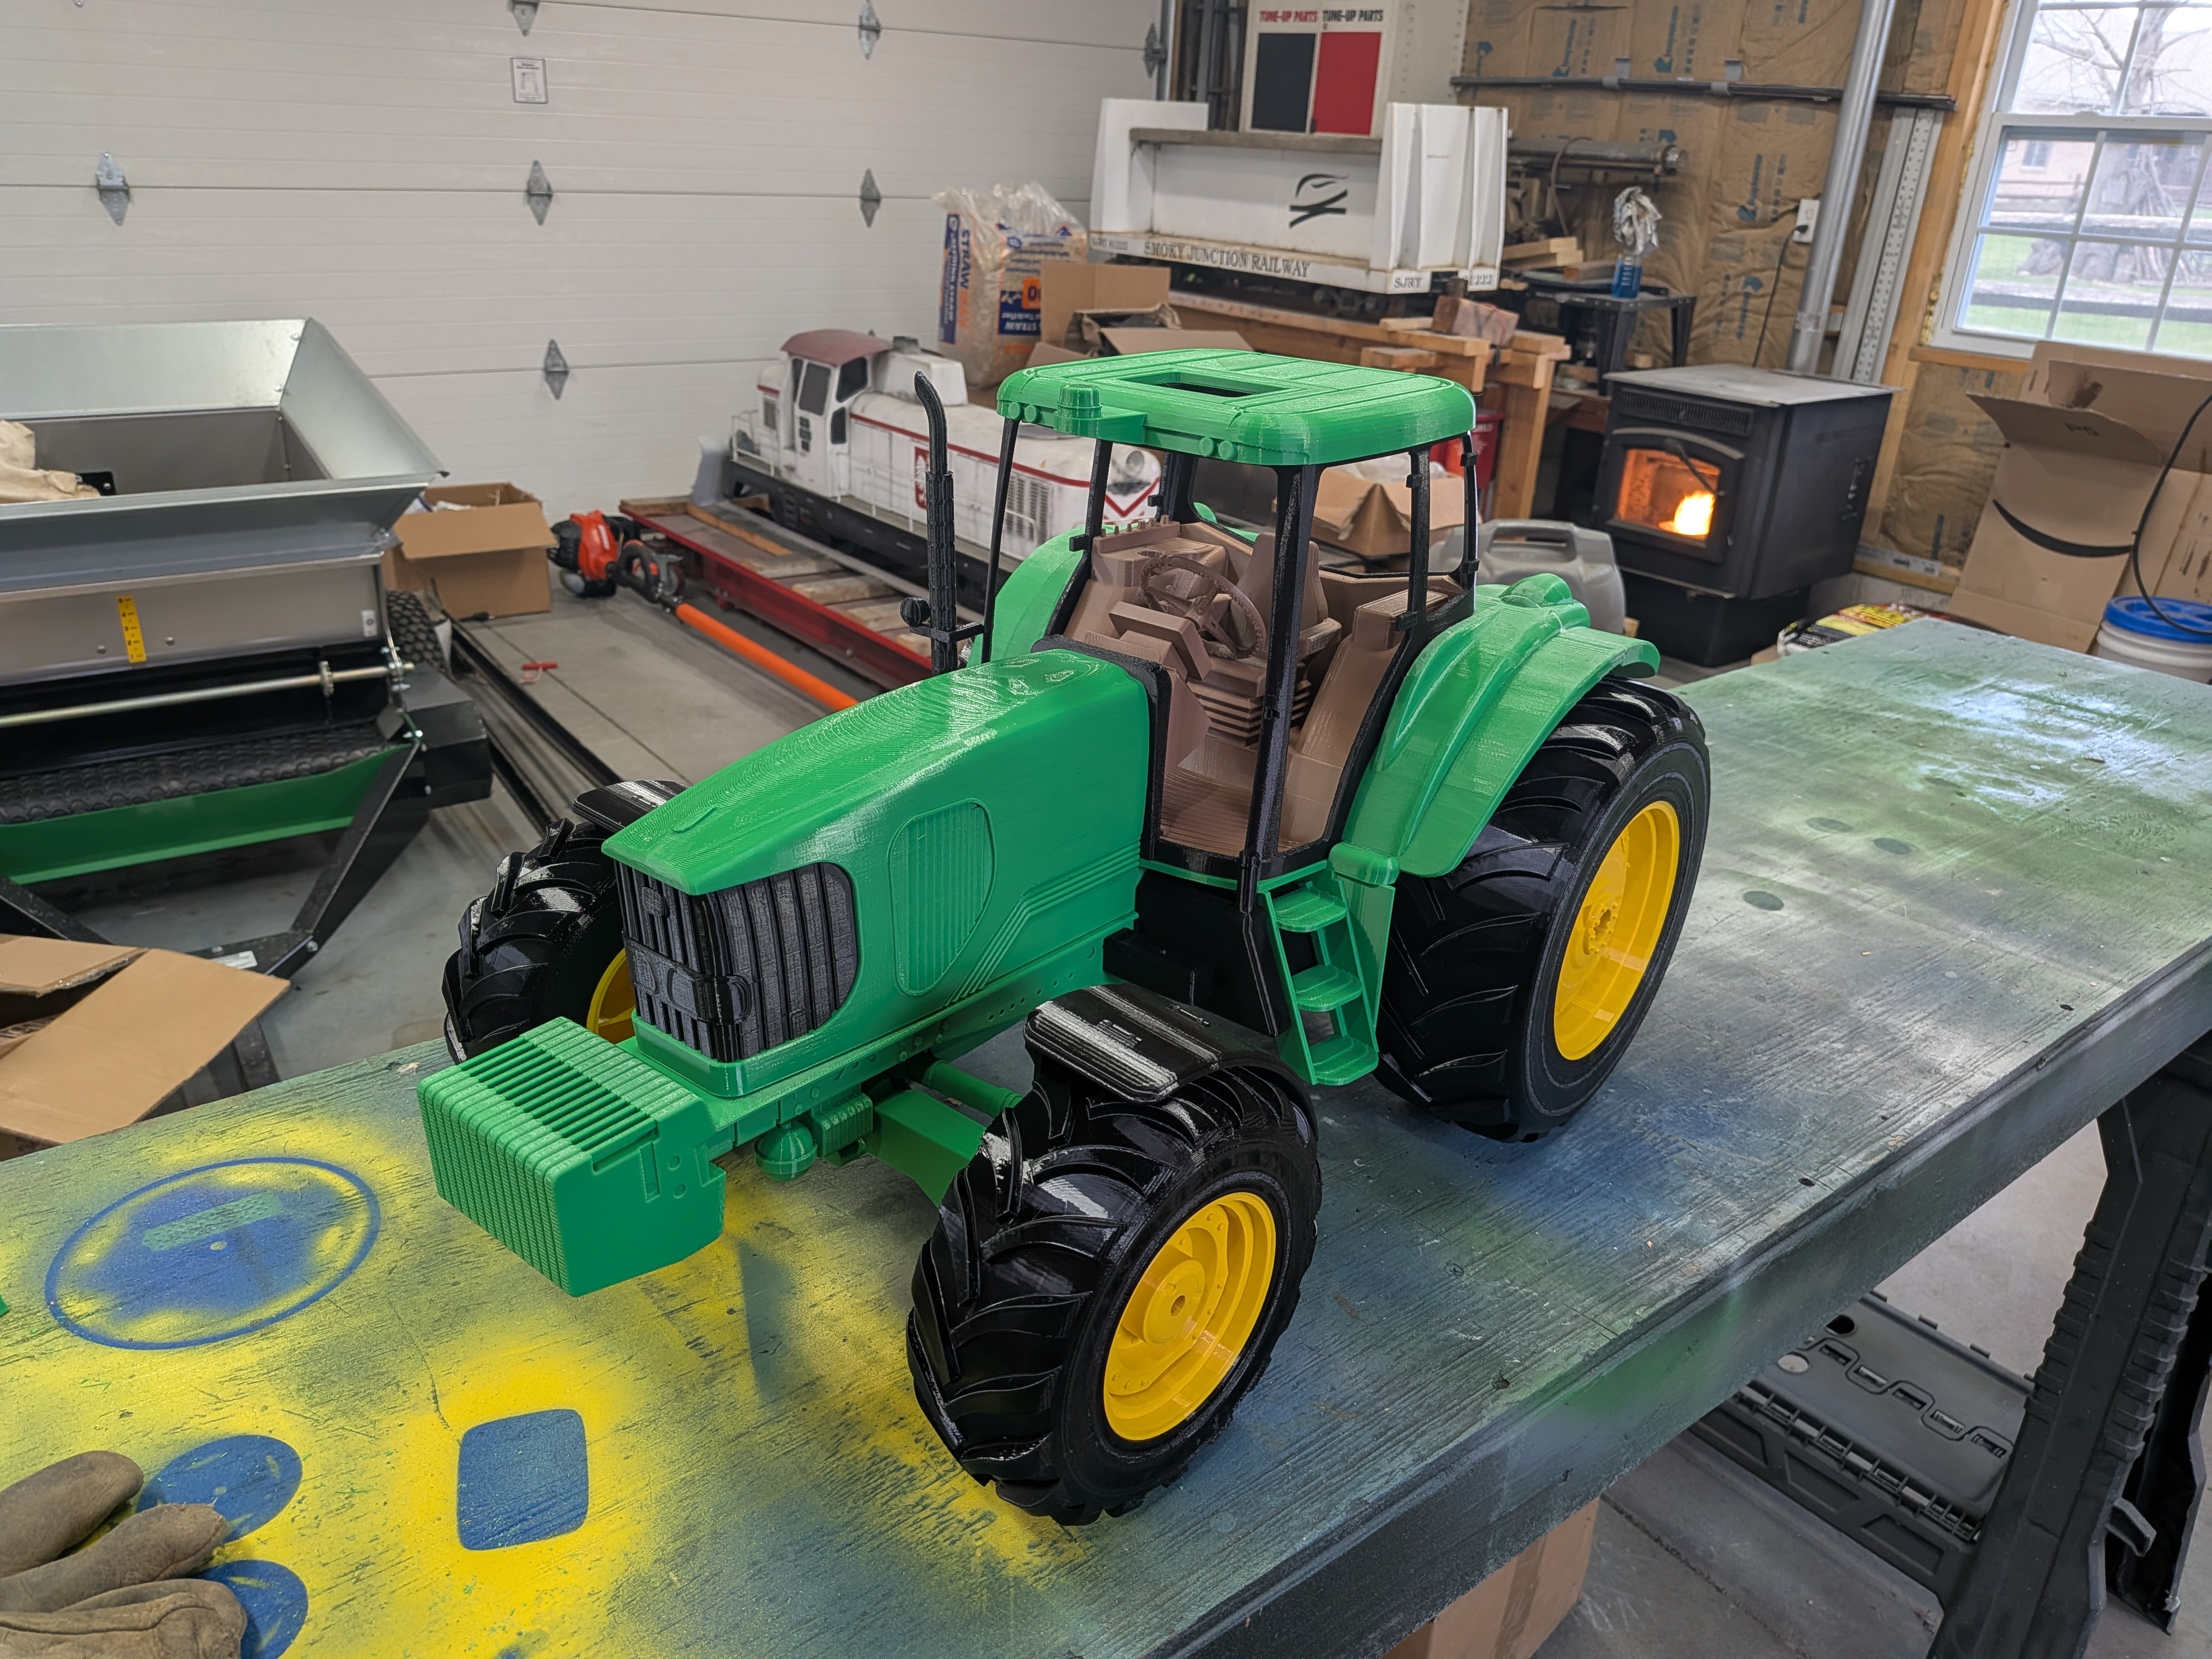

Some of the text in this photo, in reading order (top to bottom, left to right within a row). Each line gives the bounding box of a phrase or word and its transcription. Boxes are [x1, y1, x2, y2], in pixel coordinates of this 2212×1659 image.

[1260, 11, 1318, 23] TUNE-UP PARTS
[1322, 10, 1384, 22] TUNE-UP PARTS
[1144, 241, 1186, 259] SMOKY
[1187, 246, 1249, 268] JUNCTION
[1251, 255, 1311, 278] RAILWAY
[1394, 277, 1423, 289] SJRY
